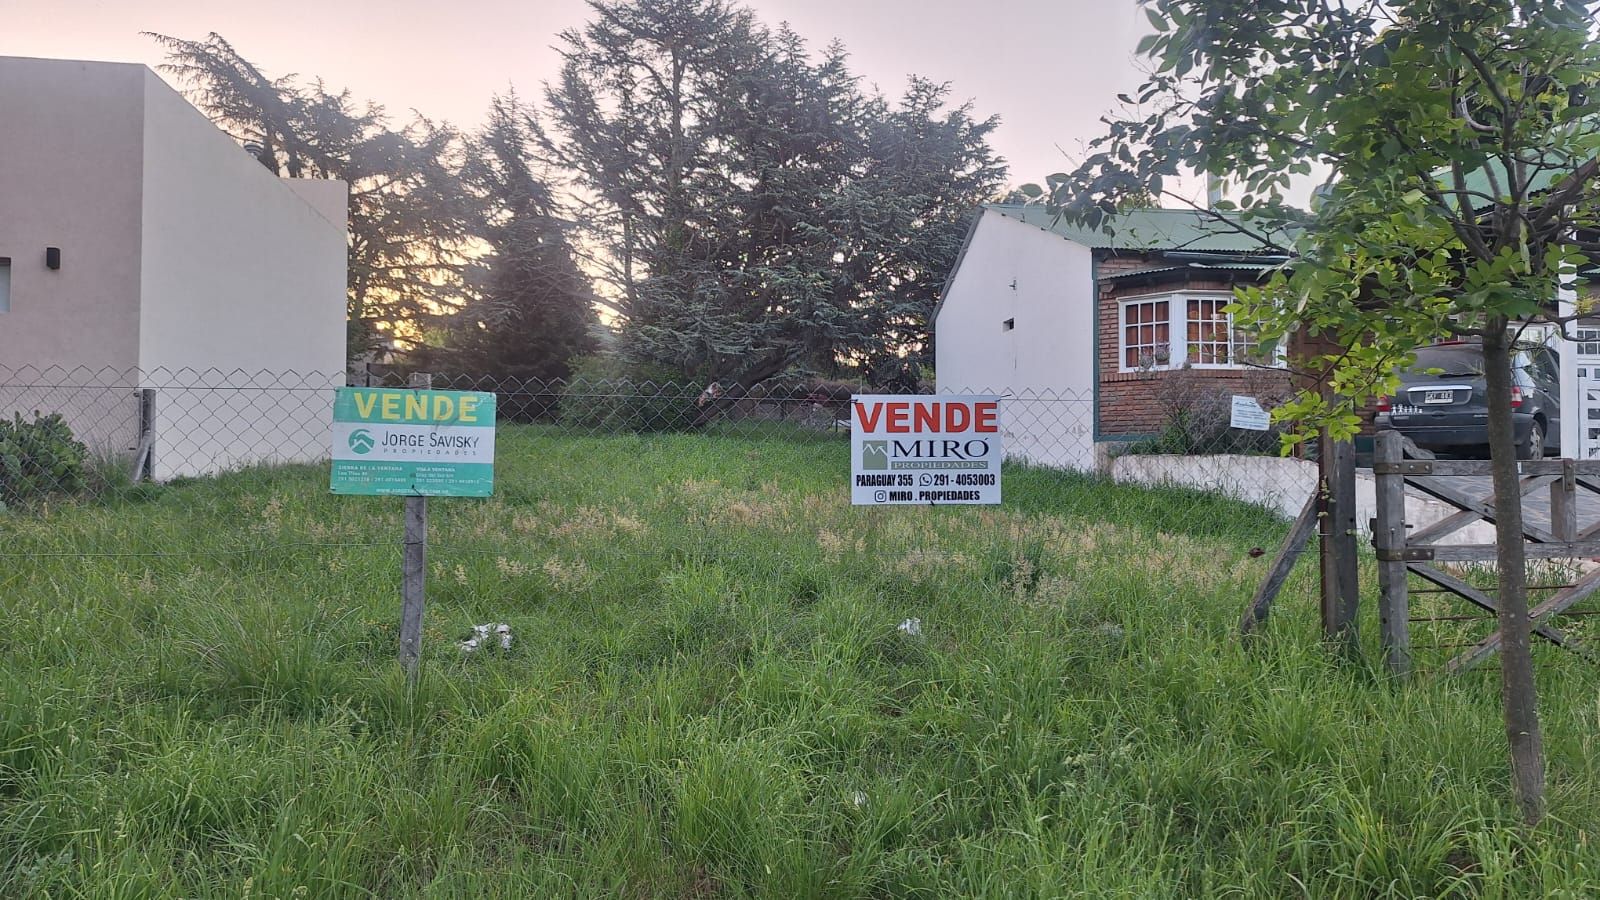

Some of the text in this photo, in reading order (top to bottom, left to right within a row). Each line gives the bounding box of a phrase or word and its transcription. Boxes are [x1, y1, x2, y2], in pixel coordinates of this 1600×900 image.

[353, 392, 479, 422] VENDE
[855, 402, 998, 433] VENDE
[382, 430, 480, 448] JORGE SAVISKY
[383, 448, 477, 456] PROPIEDADES
[891, 437, 989, 460] MIRÓ
[893, 461, 987, 469] PROPIEDADES
[856, 474, 913, 487] PARAGUAY 355
[934, 474, 949, 486] 291
[955, 473, 996, 486] 4053003
[889, 490, 913, 501] MIRO
[919, 490, 981, 501] PROPIEDADES
